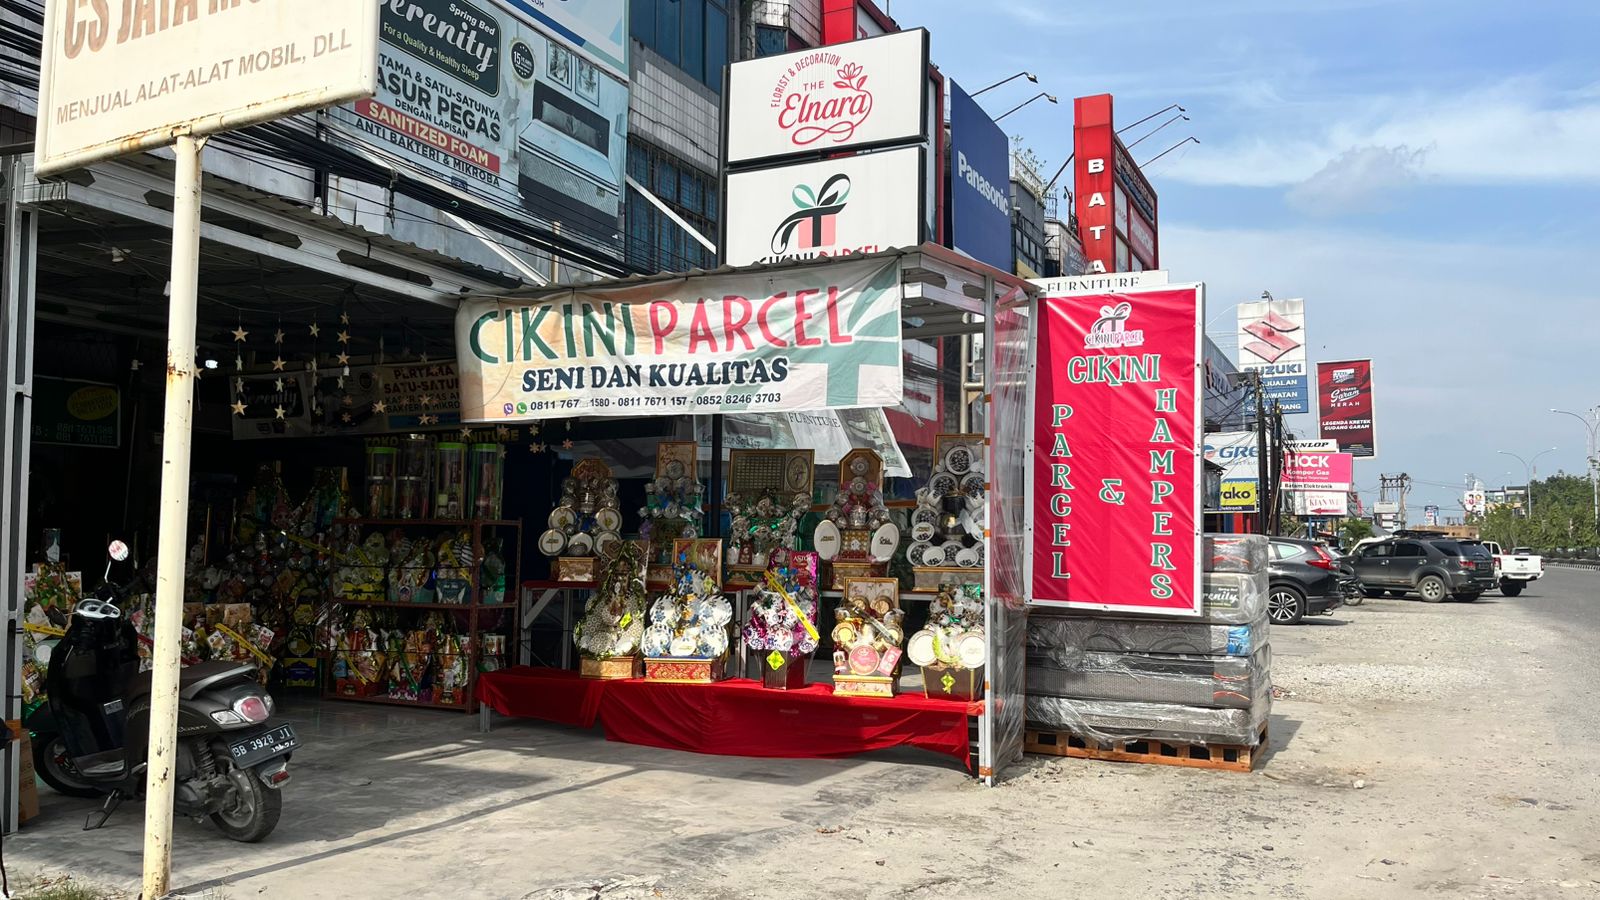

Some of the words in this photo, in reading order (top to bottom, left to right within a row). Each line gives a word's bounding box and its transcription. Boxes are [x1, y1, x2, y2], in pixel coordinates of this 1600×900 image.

[64, 0, 109, 59] CS
[380, 0, 494, 72] erenity
[449, 3, 477, 25] Spring
[478, 21, 495, 36] Bed
[384, 22, 396, 36] For
[396, 31, 402, 39] a
[402, 33, 428, 55] Quality
[428, 46, 435, 56] &
[435, 49, 462, 72] Healthy
[461, 63, 480, 81] Sleep
[513, 51, 521, 65] 15
[56, 91, 132, 125] MENJUAL
[136, 59, 234, 104] ALAT-ALAT
[238, 43, 307, 77] MOBIL,
[313, 28, 352, 57] DLL
[379, 53, 412, 79] TAMA
[415, 71, 422, 84] &
[425, 76, 500, 122] SATU-SATUNYA
[771, 74, 790, 108] FLORIST
[788, 68, 796, 77] &
[795, 52, 842, 72] DECORATION
[803, 80, 825, 91] THE
[395, 98, 432, 122] DENGAN
[433, 115, 468, 139] LAPISAN
[437, 96, 500, 142] PEGAS
[778, 92, 869, 129] Elnara
[355, 117, 387, 141] ANTI
[390, 132, 439, 161] BAKTERI
[442, 153, 450, 165] &
[453, 155, 500, 187] MIKROBA
[369, 102, 448, 147] SANITIZED
[450, 138, 489, 167] FOAM
[958, 150, 1008, 217] Panasonic
[1047, 277, 1140, 292] FURNITURE
[469, 302, 636, 364] CIKINI
[649, 286, 853, 355] PARCEL
[522, 366, 585, 392] SENI
[590, 365, 642, 388] DAN
[649, 357, 788, 387] KUALITAS
[1067, 354, 1161, 386] CIKINI
[530, 399, 556, 410] 0811
[560, 399, 580, 409] 767
[590, 398, 610, 407] 1580
[618, 398, 640, 407] 0811
[644, 397, 667, 406] 7671
[670, 396, 687, 405] 157
[696, 395, 722, 405] 0852
[725, 394, 752, 404] 8246
[755, 392, 781, 403] 3703
[1249, 391, 1298, 399] PRAWATAN
[1331, 388, 1360, 403] Garam
[788, 412, 841, 428] FURNITURE
[1288, 455, 1330, 468] HOCK
[1050, 404, 1075, 579] PARCEL
[1099, 478, 1125, 505] &
[1150, 388, 1178, 599] HAMPERS
[1221, 487, 1251, 499] ako
[250, 735, 274, 750] 3928
